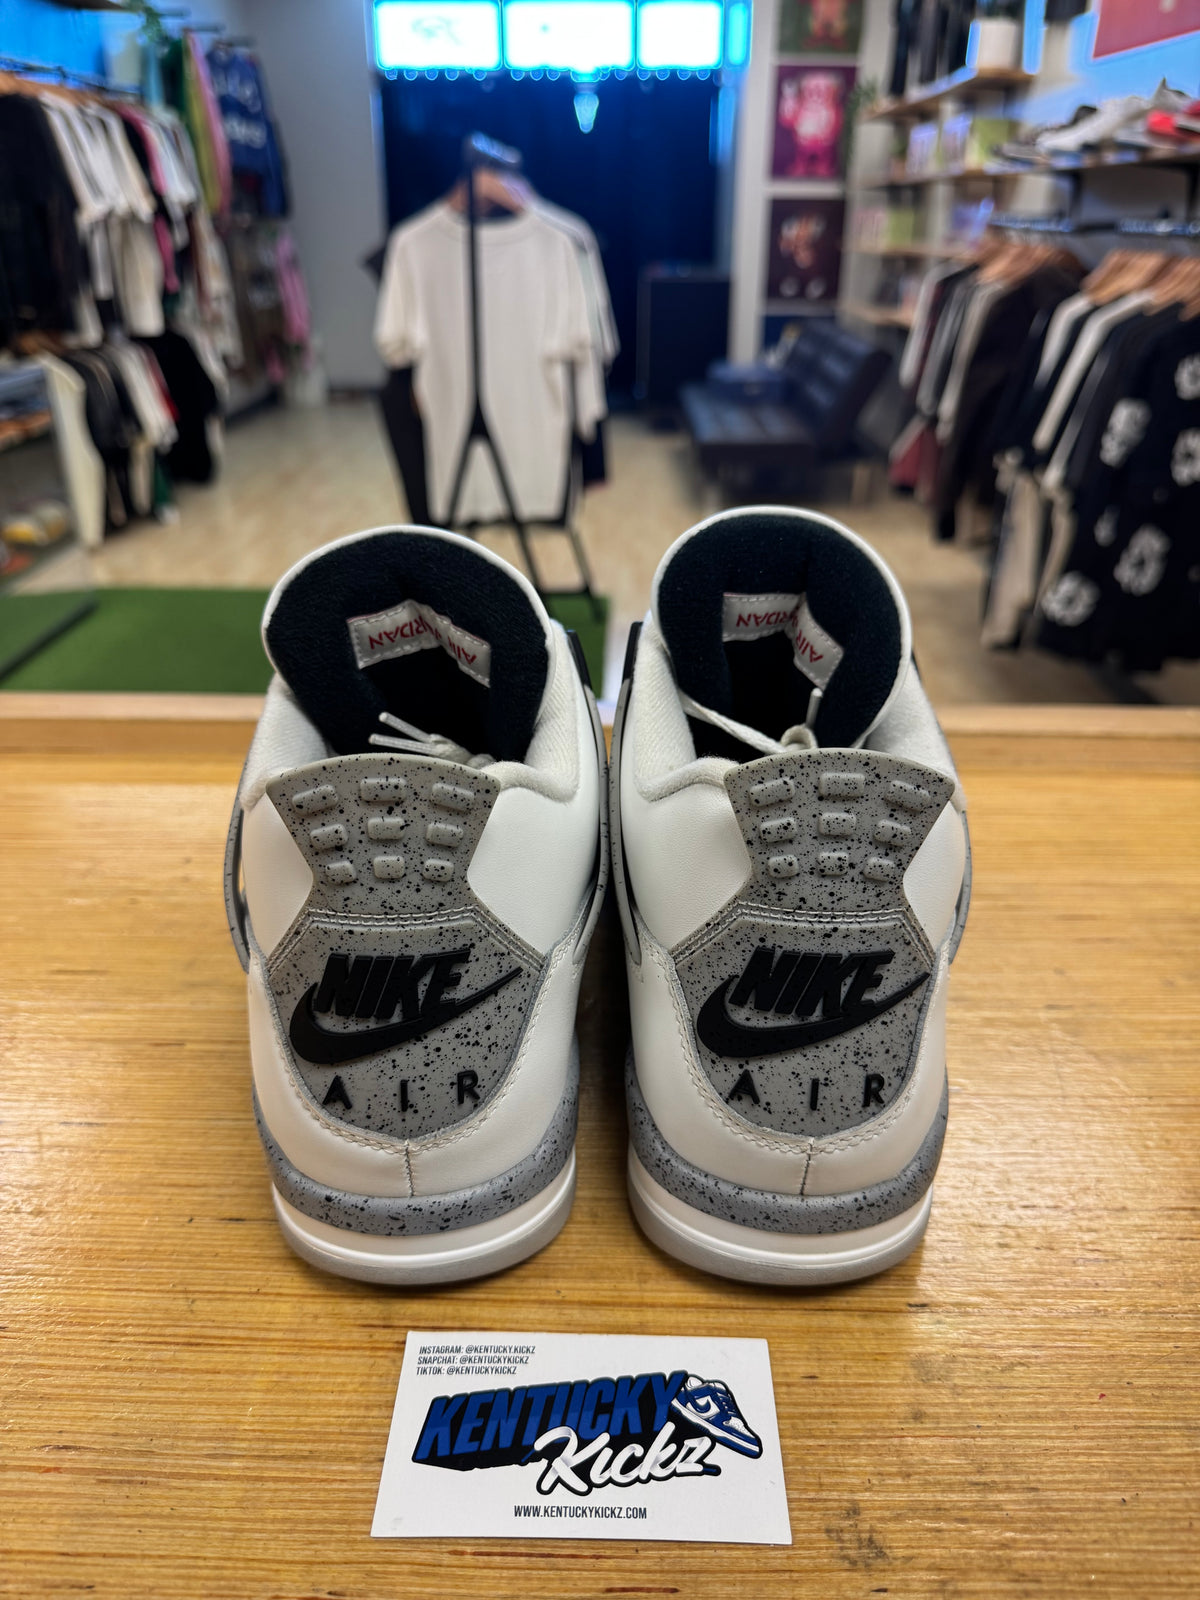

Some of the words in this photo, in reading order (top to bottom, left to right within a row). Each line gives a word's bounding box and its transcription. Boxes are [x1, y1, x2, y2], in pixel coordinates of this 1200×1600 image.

[796, 629, 824, 663] AIR
[312, 949, 472, 1019] NIKE
[728, 946, 896, 1019] NIKE
[321, 1069, 481, 1112] AIR
[726, 1069, 886, 1111] AIR
[417, 1355, 458, 1364] SNAPCHAT:
[459, 1355, 530, 1364] @KENTUCKYKICKZ
[418, 1345, 464, 1354] INSTAGRAM:
[465, 1344, 536, 1354] @KENTUCKY.KICKZ
[416, 1366, 445, 1375] TIKTOK:
[446, 1366, 517, 1375] @KENTUCKYKICKZ
[413, 1371, 688, 1461] KENTUCKY
[514, 1505, 647, 1519] WWW.KENTUCKYKICKZ.COM
